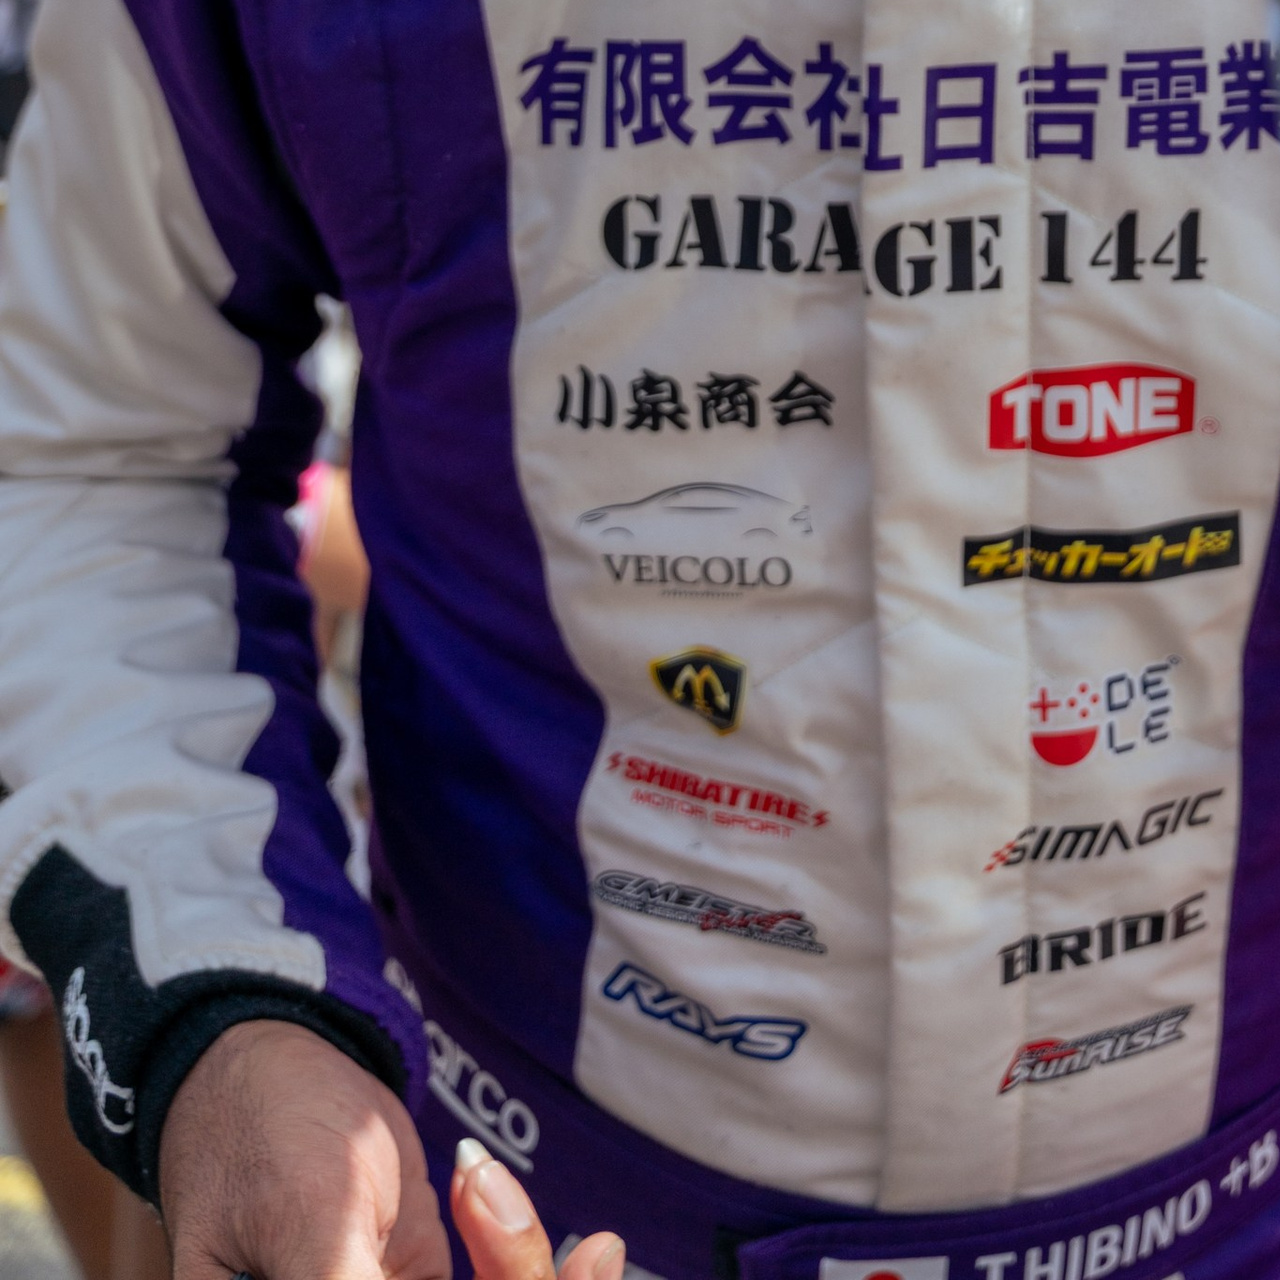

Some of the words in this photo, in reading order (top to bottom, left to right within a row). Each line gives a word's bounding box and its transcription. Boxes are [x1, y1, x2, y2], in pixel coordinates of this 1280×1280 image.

[602, 194, 1004, 298] GARAGE
[1038, 208, 1210, 284] 144
[557, 363, 836, 432] 小泉商会
[1001, 376, 1182, 444] TONE
[602, 552, 794, 588] VEICOLO
[999, 788, 1225, 868] SIMAGIC
[997, 891, 1207, 987] BRIDE
[602, 961, 808, 1061] RAYS
